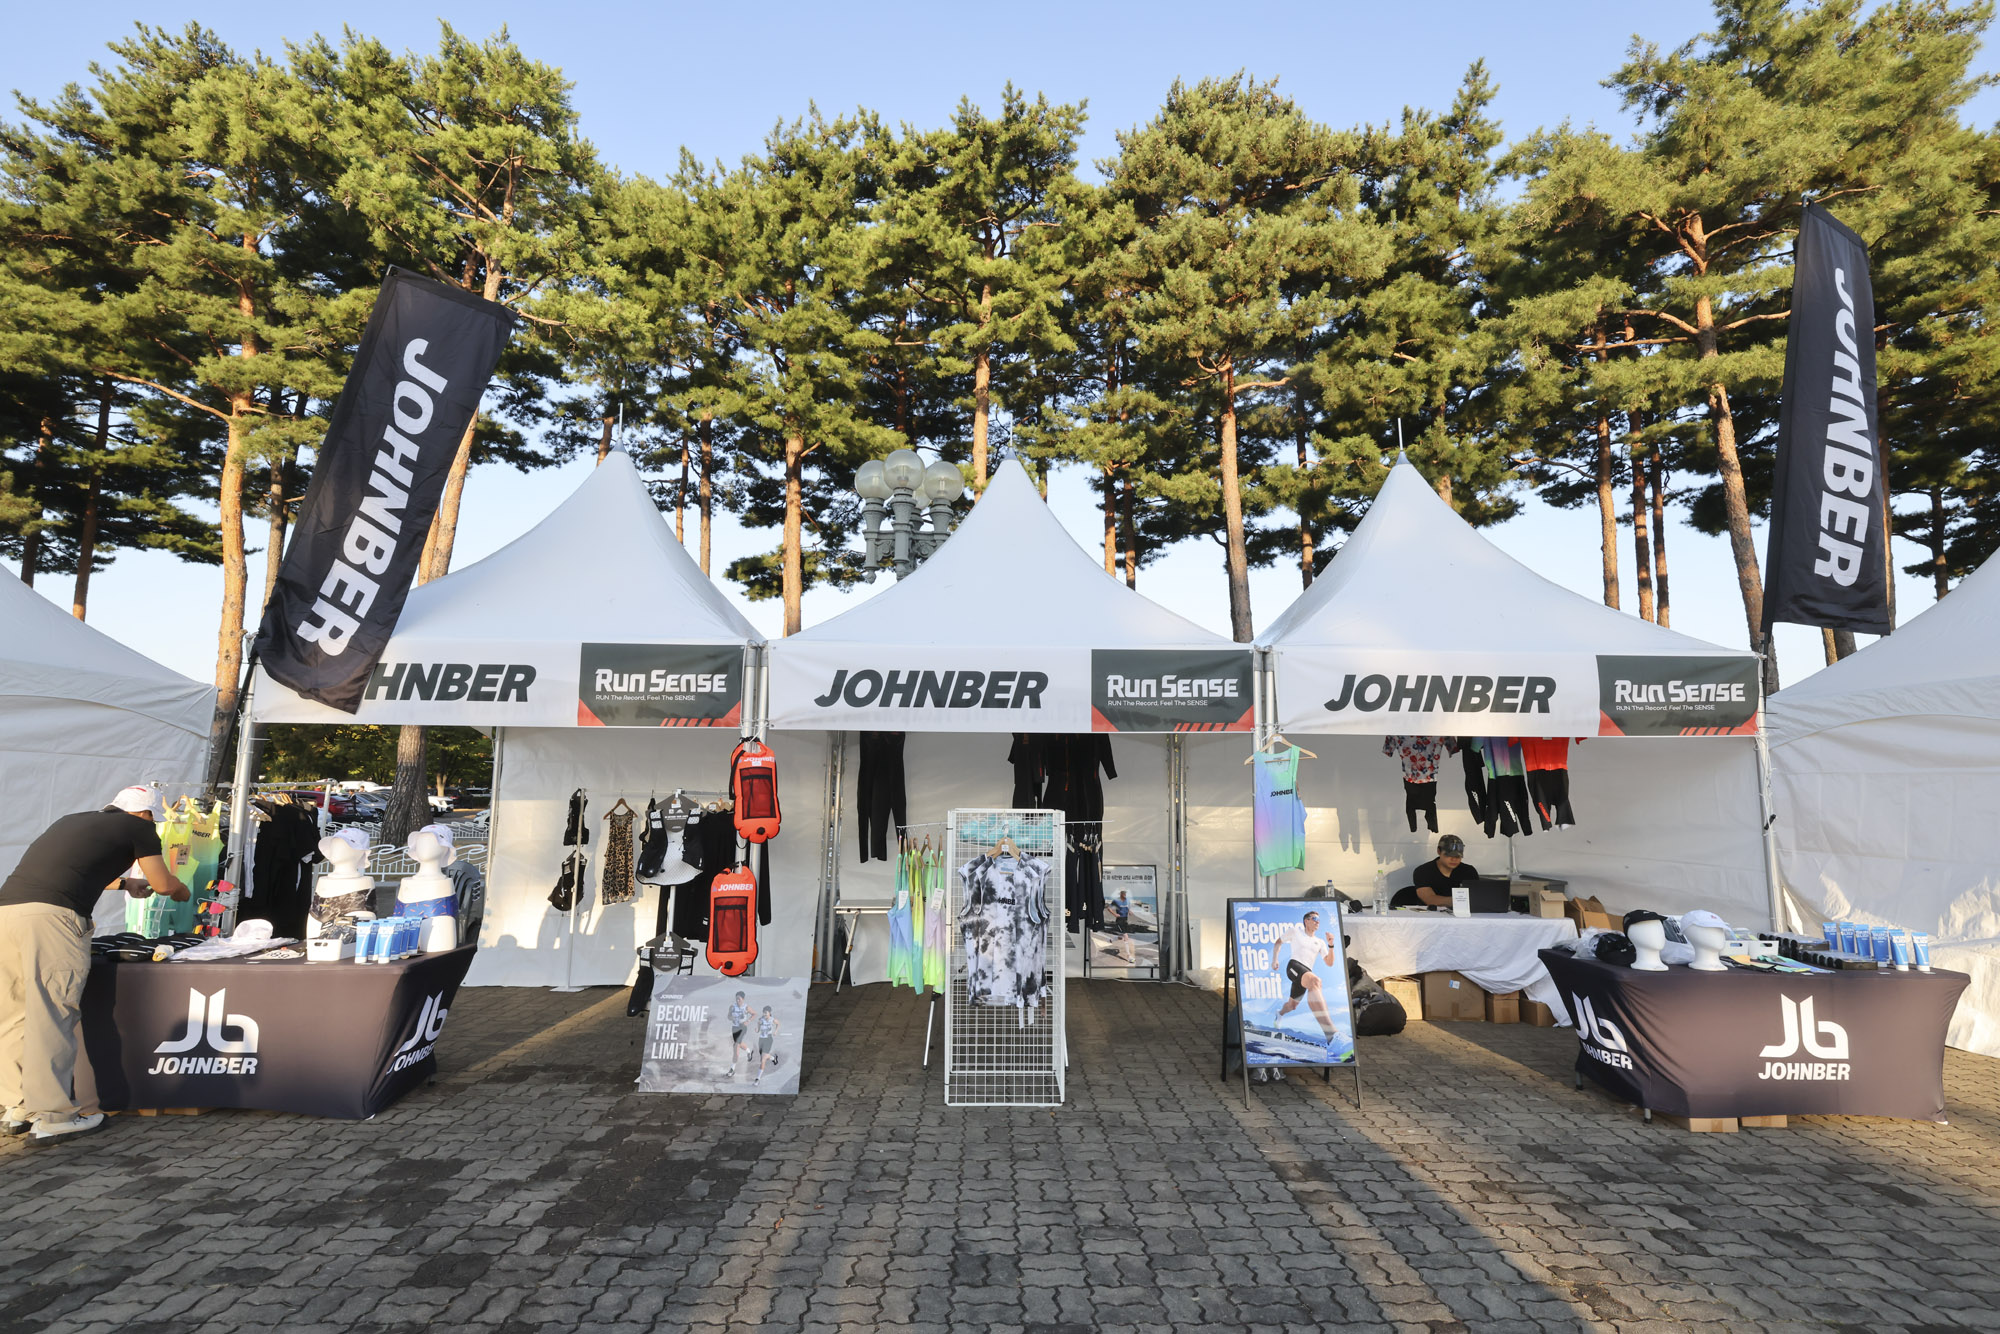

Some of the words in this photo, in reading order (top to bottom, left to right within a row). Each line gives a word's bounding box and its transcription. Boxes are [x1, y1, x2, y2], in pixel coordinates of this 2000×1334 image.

[1814, 267, 1874, 587] JOHNBER
[297, 338, 448, 657] JOHNBER
[364, 662, 537, 702] HNBER
[814, 669, 1049, 709] JOHNBER
[1323, 674, 1556, 714] JOHNBER
[1240, 945, 1269, 971] the
[1243, 973, 1283, 1000] limit
[657, 1004, 709, 1022] BECOME
[655, 1023, 679, 1041] THE
[651, 1042, 687, 1060] LIMIT
[148, 1057, 258, 1075] JOHNBER
[1758, 1061, 1850, 1081] JOHNBER
